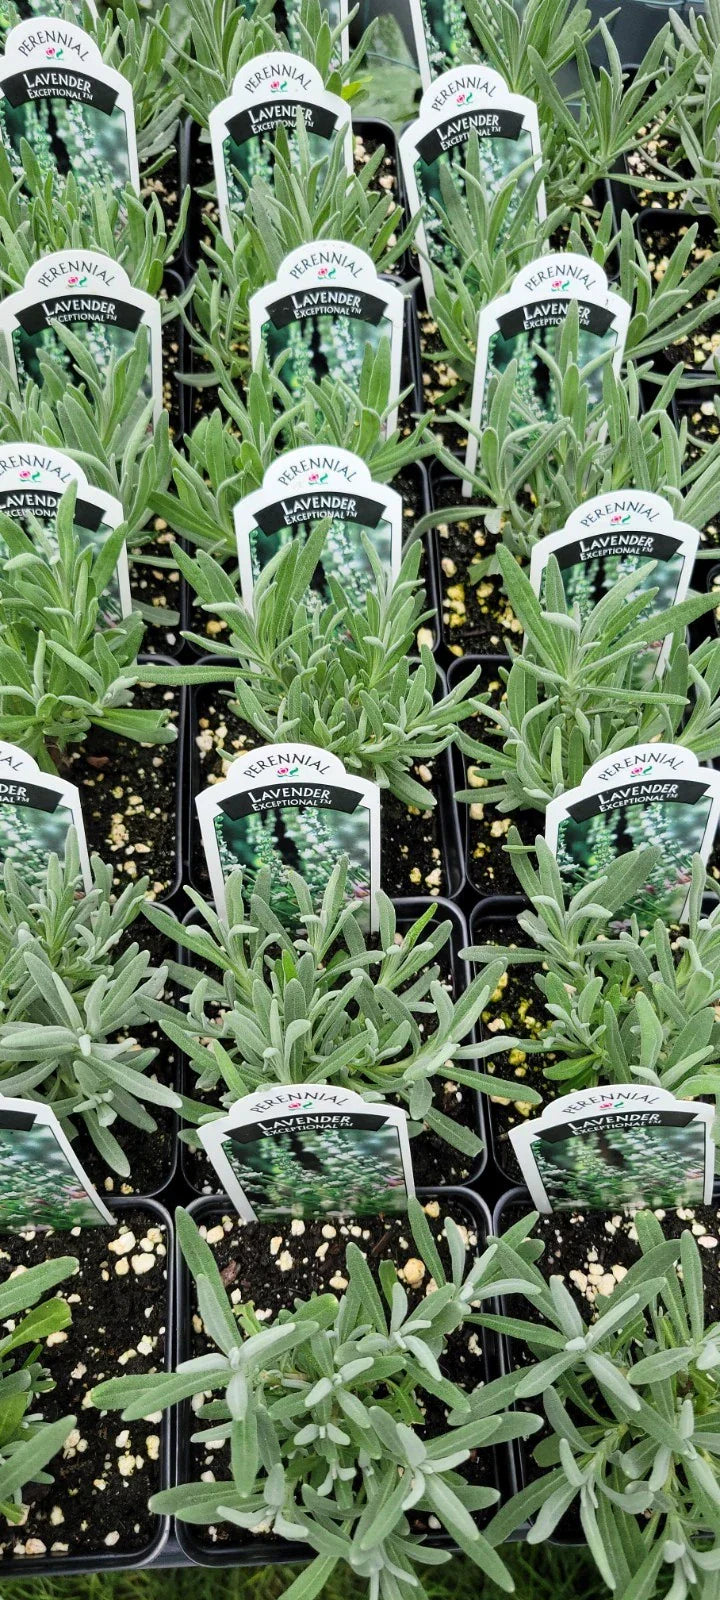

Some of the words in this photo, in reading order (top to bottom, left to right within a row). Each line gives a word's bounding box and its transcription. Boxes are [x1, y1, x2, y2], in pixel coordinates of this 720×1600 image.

[18, 30, 89, 61] PERENNIAL
[23, 73, 91, 93] LAVENDER
[245, 64, 311, 94] PERENNIAL
[27, 89, 94, 101] EXCEPTIONAL™
[431, 76, 496, 111] PERENNIAL
[251, 120, 314, 134] EXCEPTONA™
[436, 114, 499, 141] LAVENDER
[441, 127, 502, 150] EXCEPTINAL™
[38, 261, 115, 287] PERENNIAL
[289, 252, 362, 279] PERENNIAL
[525, 264, 596, 291] PERENNIAL
[42, 300, 116, 315] LAVENDER
[291, 292, 361, 309] LAVENDER
[293, 306, 362, 319] EXCEPTIONAL™
[523, 305, 591, 320] LAVENER
[524, 317, 590, 329] EXCEPTIO™
[0, 454, 71, 484] RENNIAL
[278, 458, 357, 486] PERENNIAL
[0, 494, 61, 511] AVEND
[281, 496, 357, 515] LAVENDER
[284, 510, 358, 525] EXCEPTIONAL™
[580, 501, 660, 526] PERENNIAL
[579, 536, 653, 552] LAVENDER
[580, 546, 653, 560] EXCEPTIONAL™
[244, 753, 331, 778] PERENNIAL
[598, 752, 684, 781] PERENNIAL
[248, 787, 330, 803] LAVENDER
[598, 783, 678, 804] LAVENDER
[599, 793, 678, 812] EXCEPTIONAL™
[252, 798, 332, 812] EXCEPTIONAL™
[249, 1091, 349, 1113] PERENNIAL
[562, 1092, 660, 1114] PERENNIAL
[257, 1114, 350, 1131] LAVENDER
[263, 1121, 354, 1136] EXCEPTIONAL™
[568, 1114, 660, 1131] LAVENDER
[572, 1120, 662, 1136] EXCEPTIONAL™
